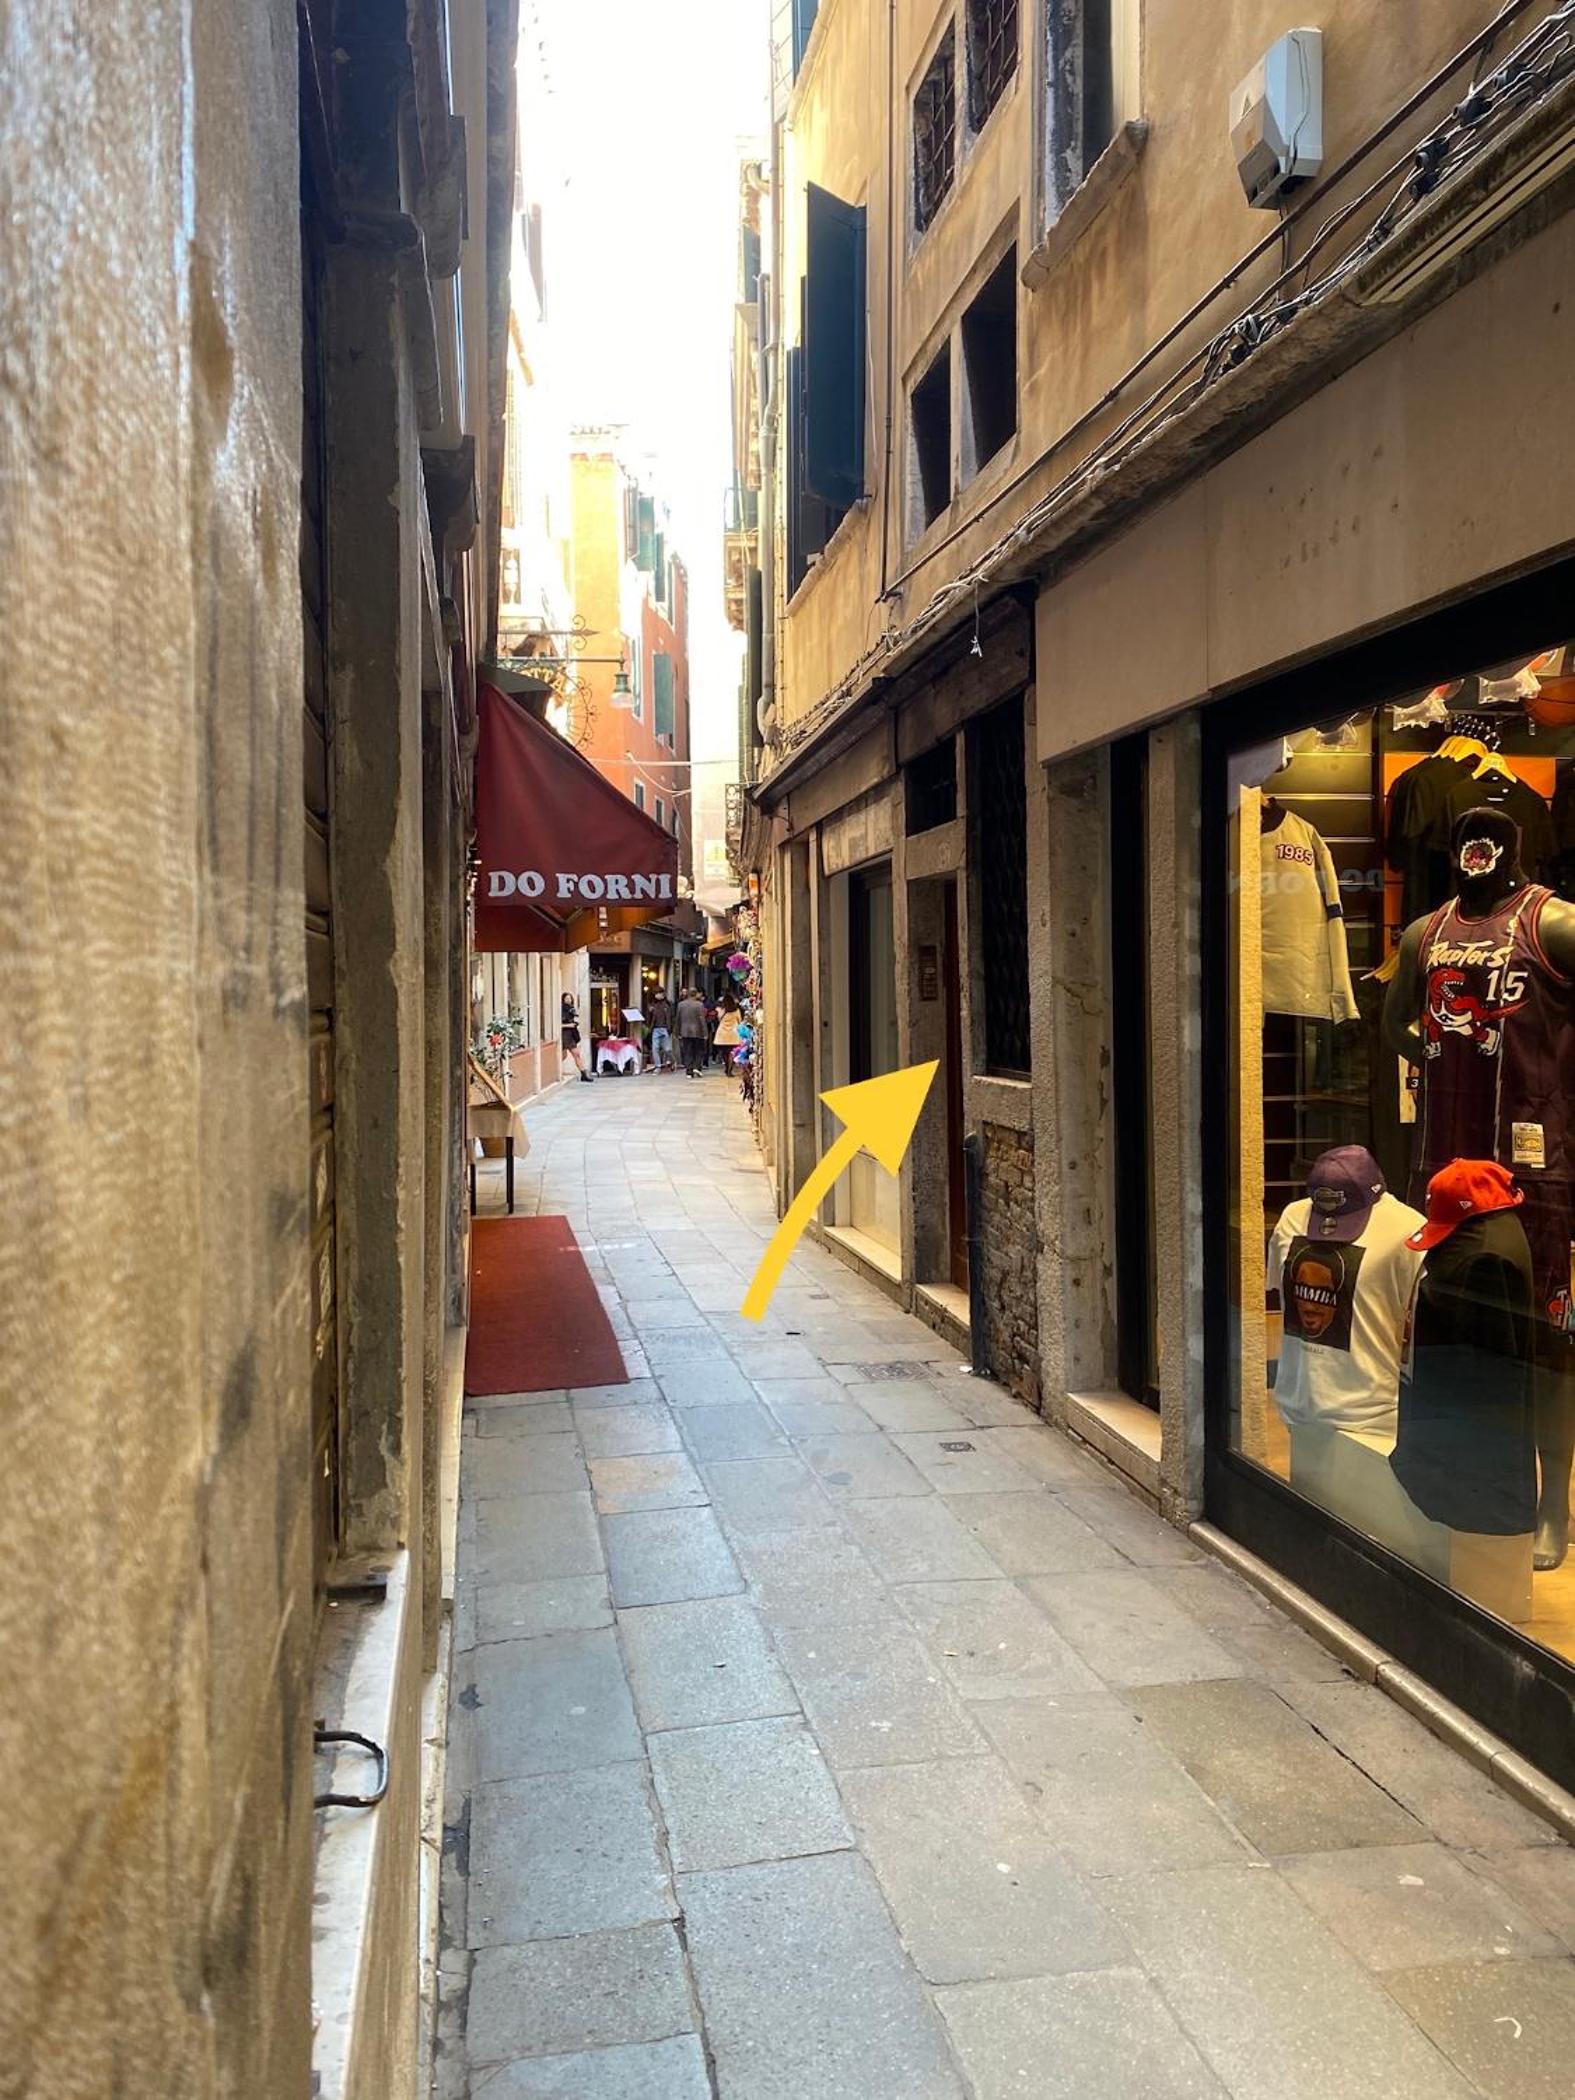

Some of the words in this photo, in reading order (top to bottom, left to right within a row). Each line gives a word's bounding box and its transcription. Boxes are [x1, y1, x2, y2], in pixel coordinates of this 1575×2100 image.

[1275, 844, 1315, 866] 1985
[488, 870, 545, 897] DO
[555, 872, 672, 900] FORNI
[1486, 970, 1529, 1001] 15
